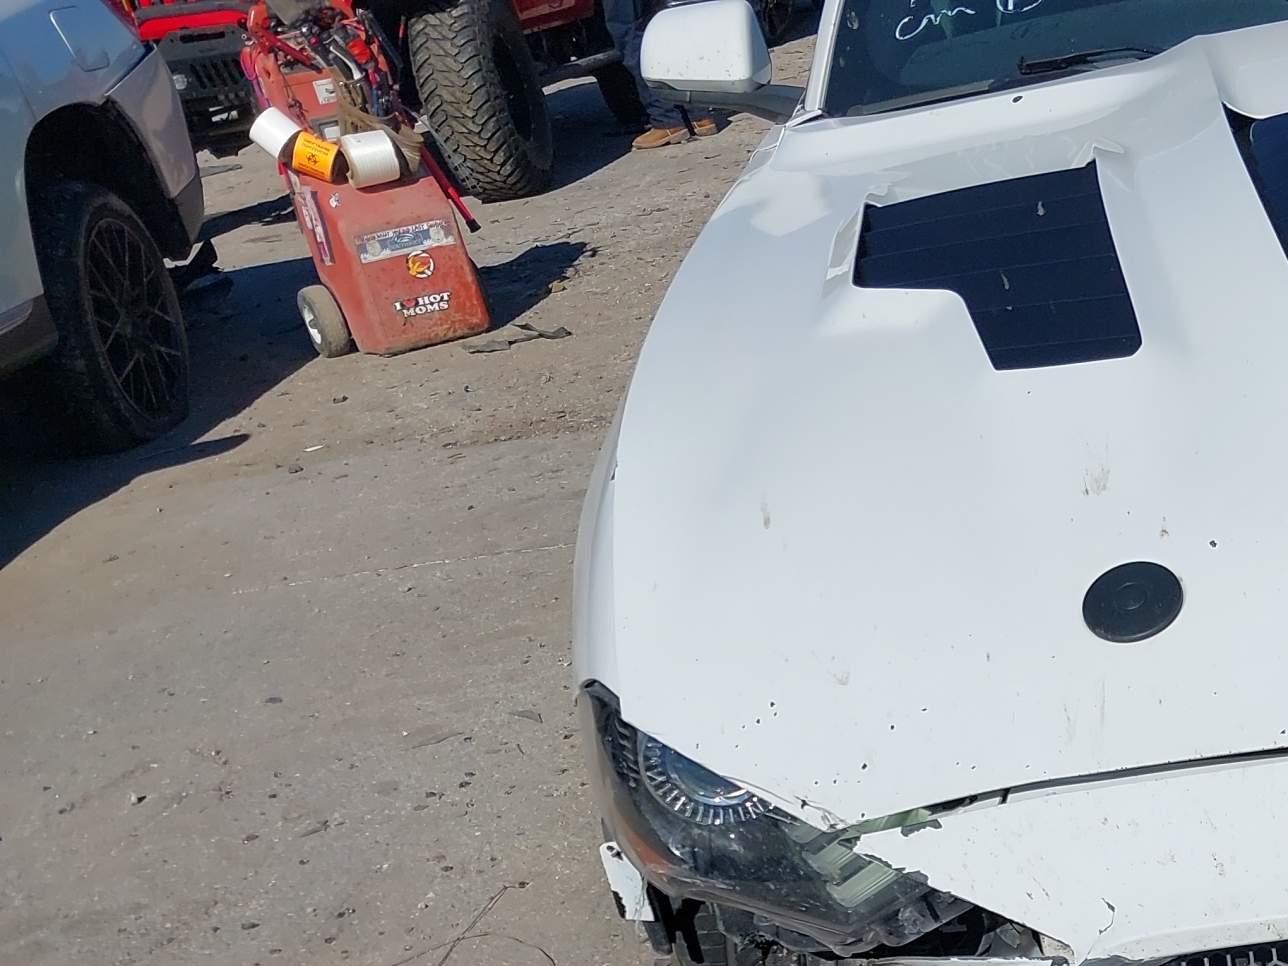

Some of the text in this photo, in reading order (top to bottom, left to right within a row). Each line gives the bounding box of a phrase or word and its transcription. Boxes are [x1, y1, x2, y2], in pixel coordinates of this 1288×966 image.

[393, 291, 451, 311] I HOT
[402, 301, 449, 318] MOMS
